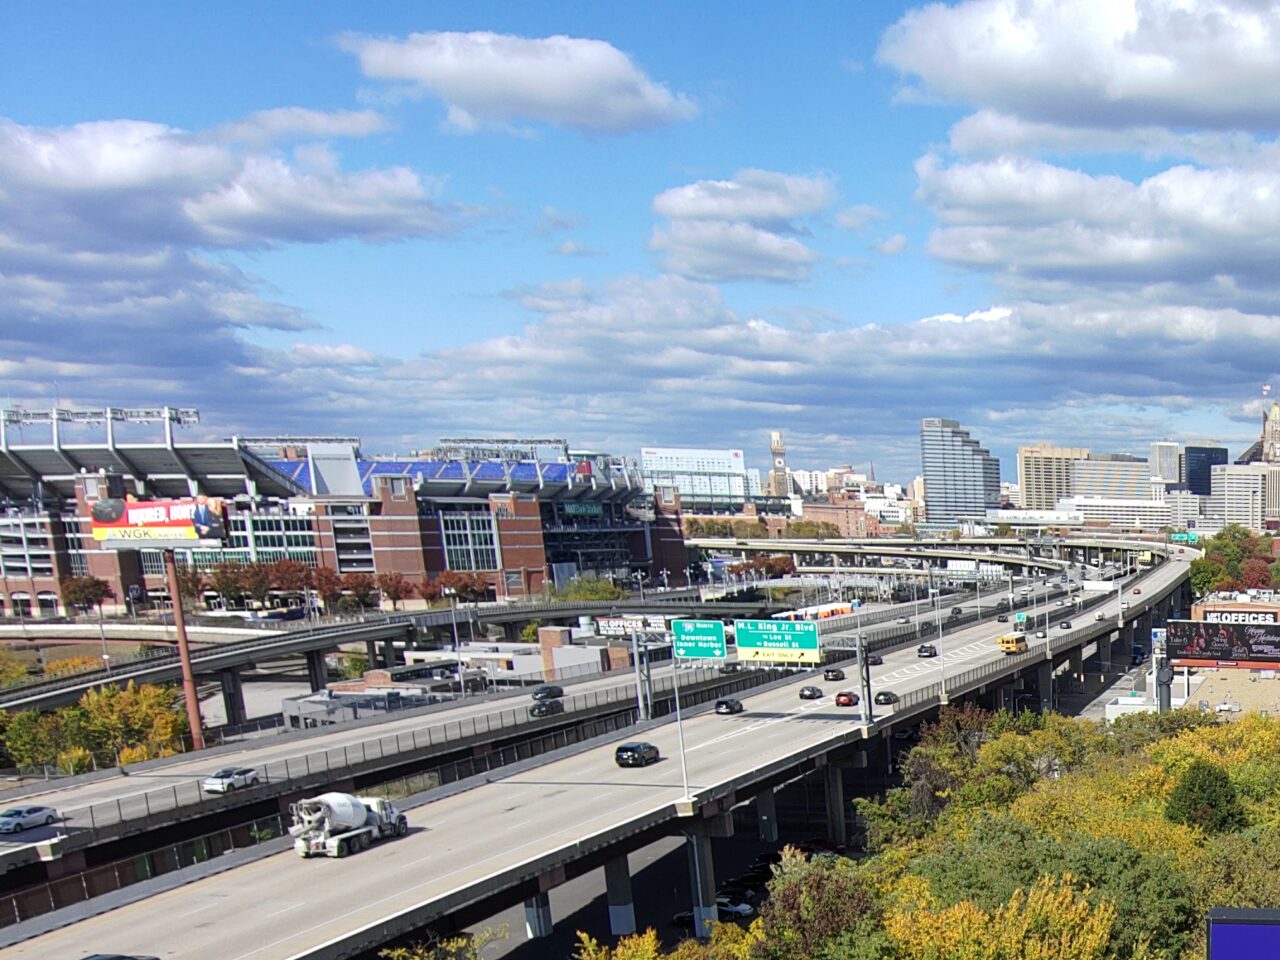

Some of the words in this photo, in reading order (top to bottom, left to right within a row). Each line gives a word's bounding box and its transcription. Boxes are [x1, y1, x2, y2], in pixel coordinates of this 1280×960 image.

[119, 529, 152, 539] WGK
[1221, 612, 1275, 624] OFFICES
[608, 620, 643, 628] OFFICES
[738, 622, 755, 630] M.L.
[758, 623, 778, 632] King
[795, 624, 815, 632] Blvd
[698, 641, 722, 649] Harbor
